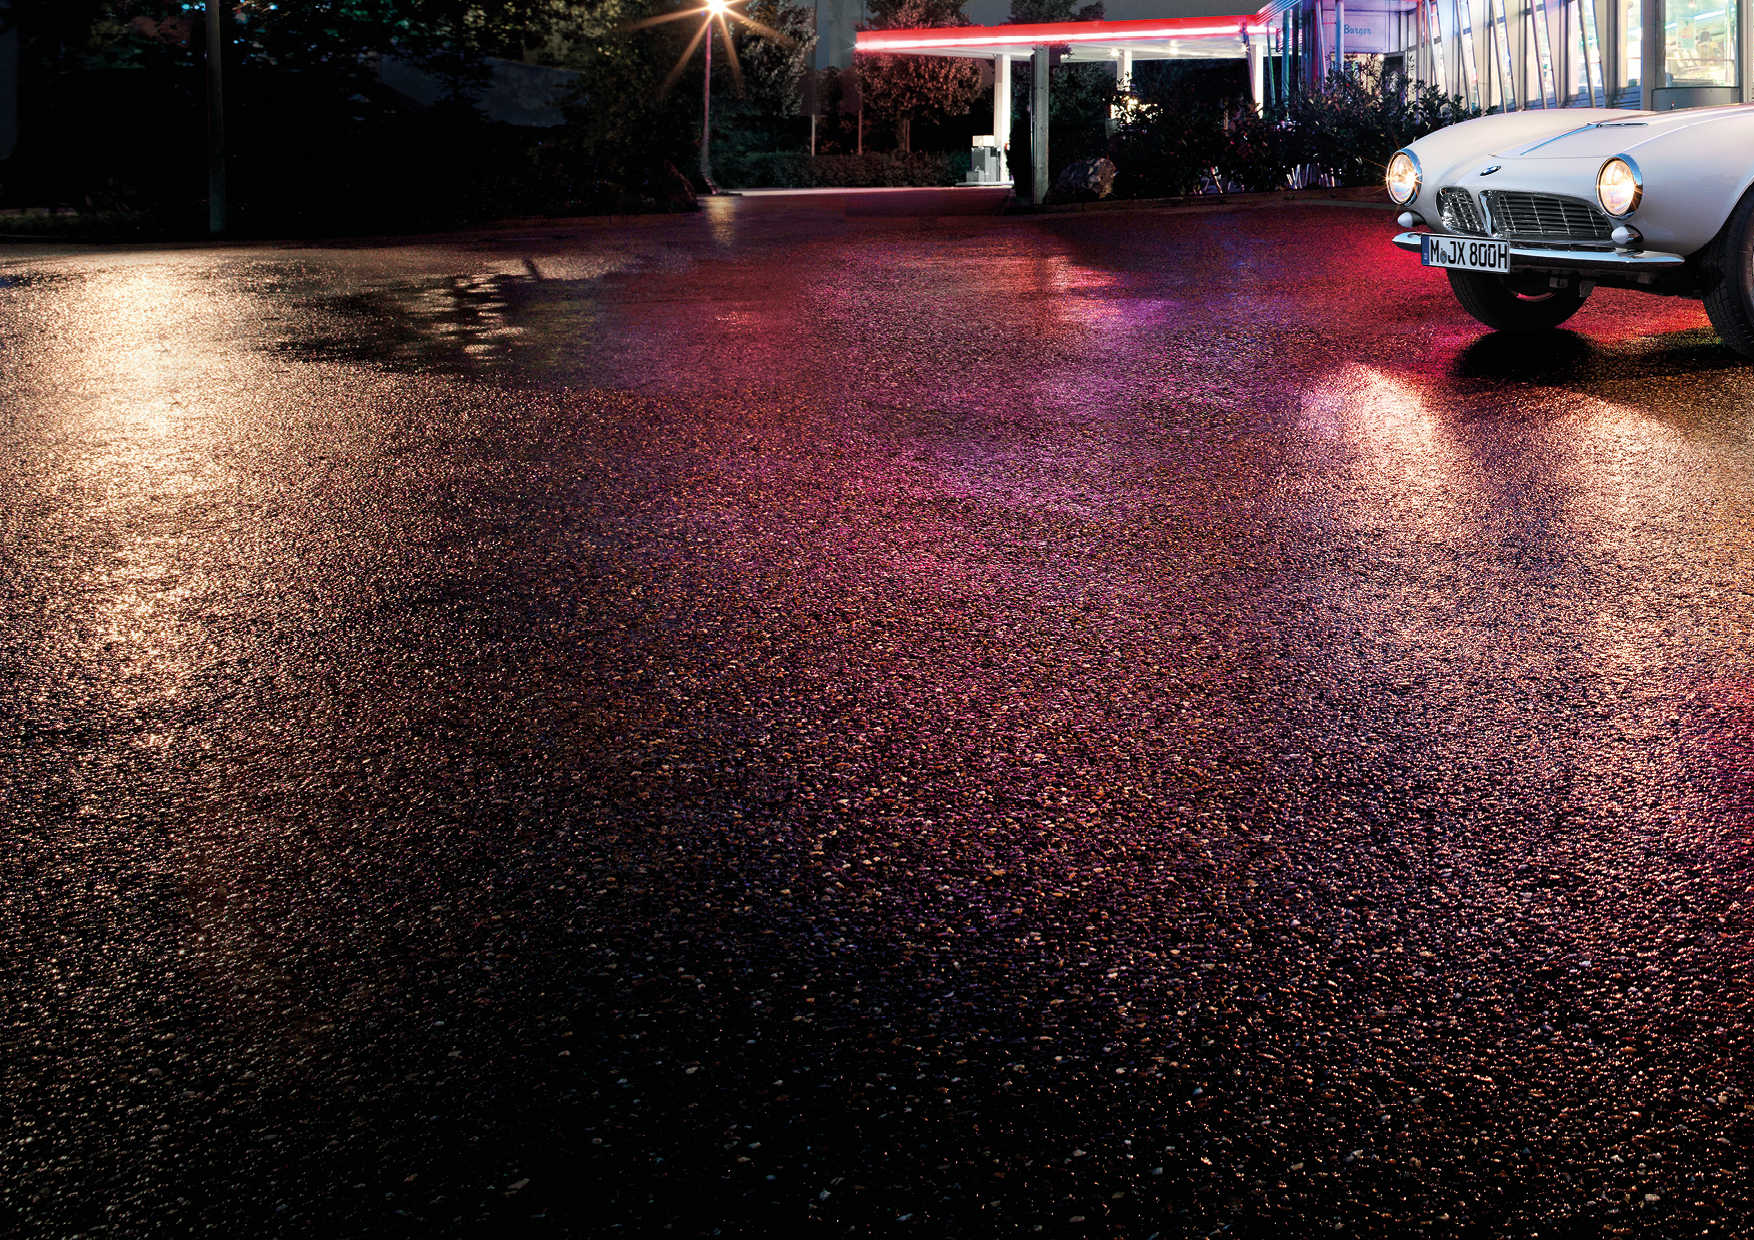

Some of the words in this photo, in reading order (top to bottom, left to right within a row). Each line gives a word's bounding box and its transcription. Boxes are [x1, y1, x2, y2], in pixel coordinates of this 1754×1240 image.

[1430, 239, 1440, 263] M
[1447, 241, 1466, 266] JX
[1469, 242, 1508, 269] 800H
